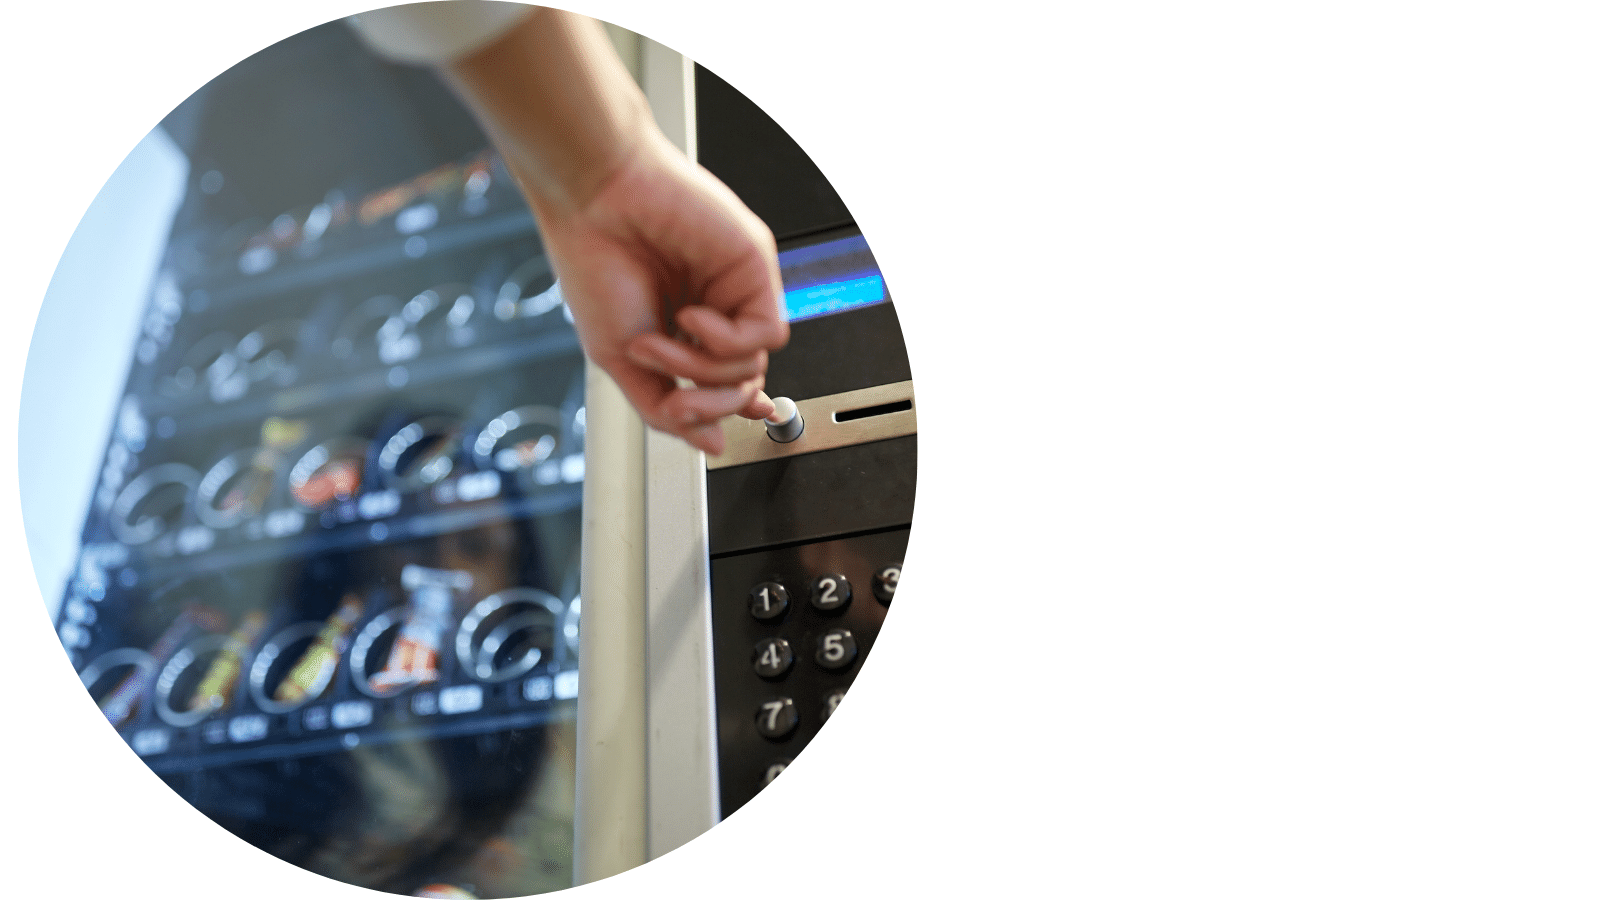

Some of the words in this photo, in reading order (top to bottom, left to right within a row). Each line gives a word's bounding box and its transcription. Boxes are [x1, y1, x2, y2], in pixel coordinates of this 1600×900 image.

[759, 588, 770, 612] 1
[818, 578, 839, 604] 2
[882, 567, 900, 593] 3
[761, 643, 781, 669] 4
[824, 634, 845, 661] 5
[763, 701, 784, 730] 7
